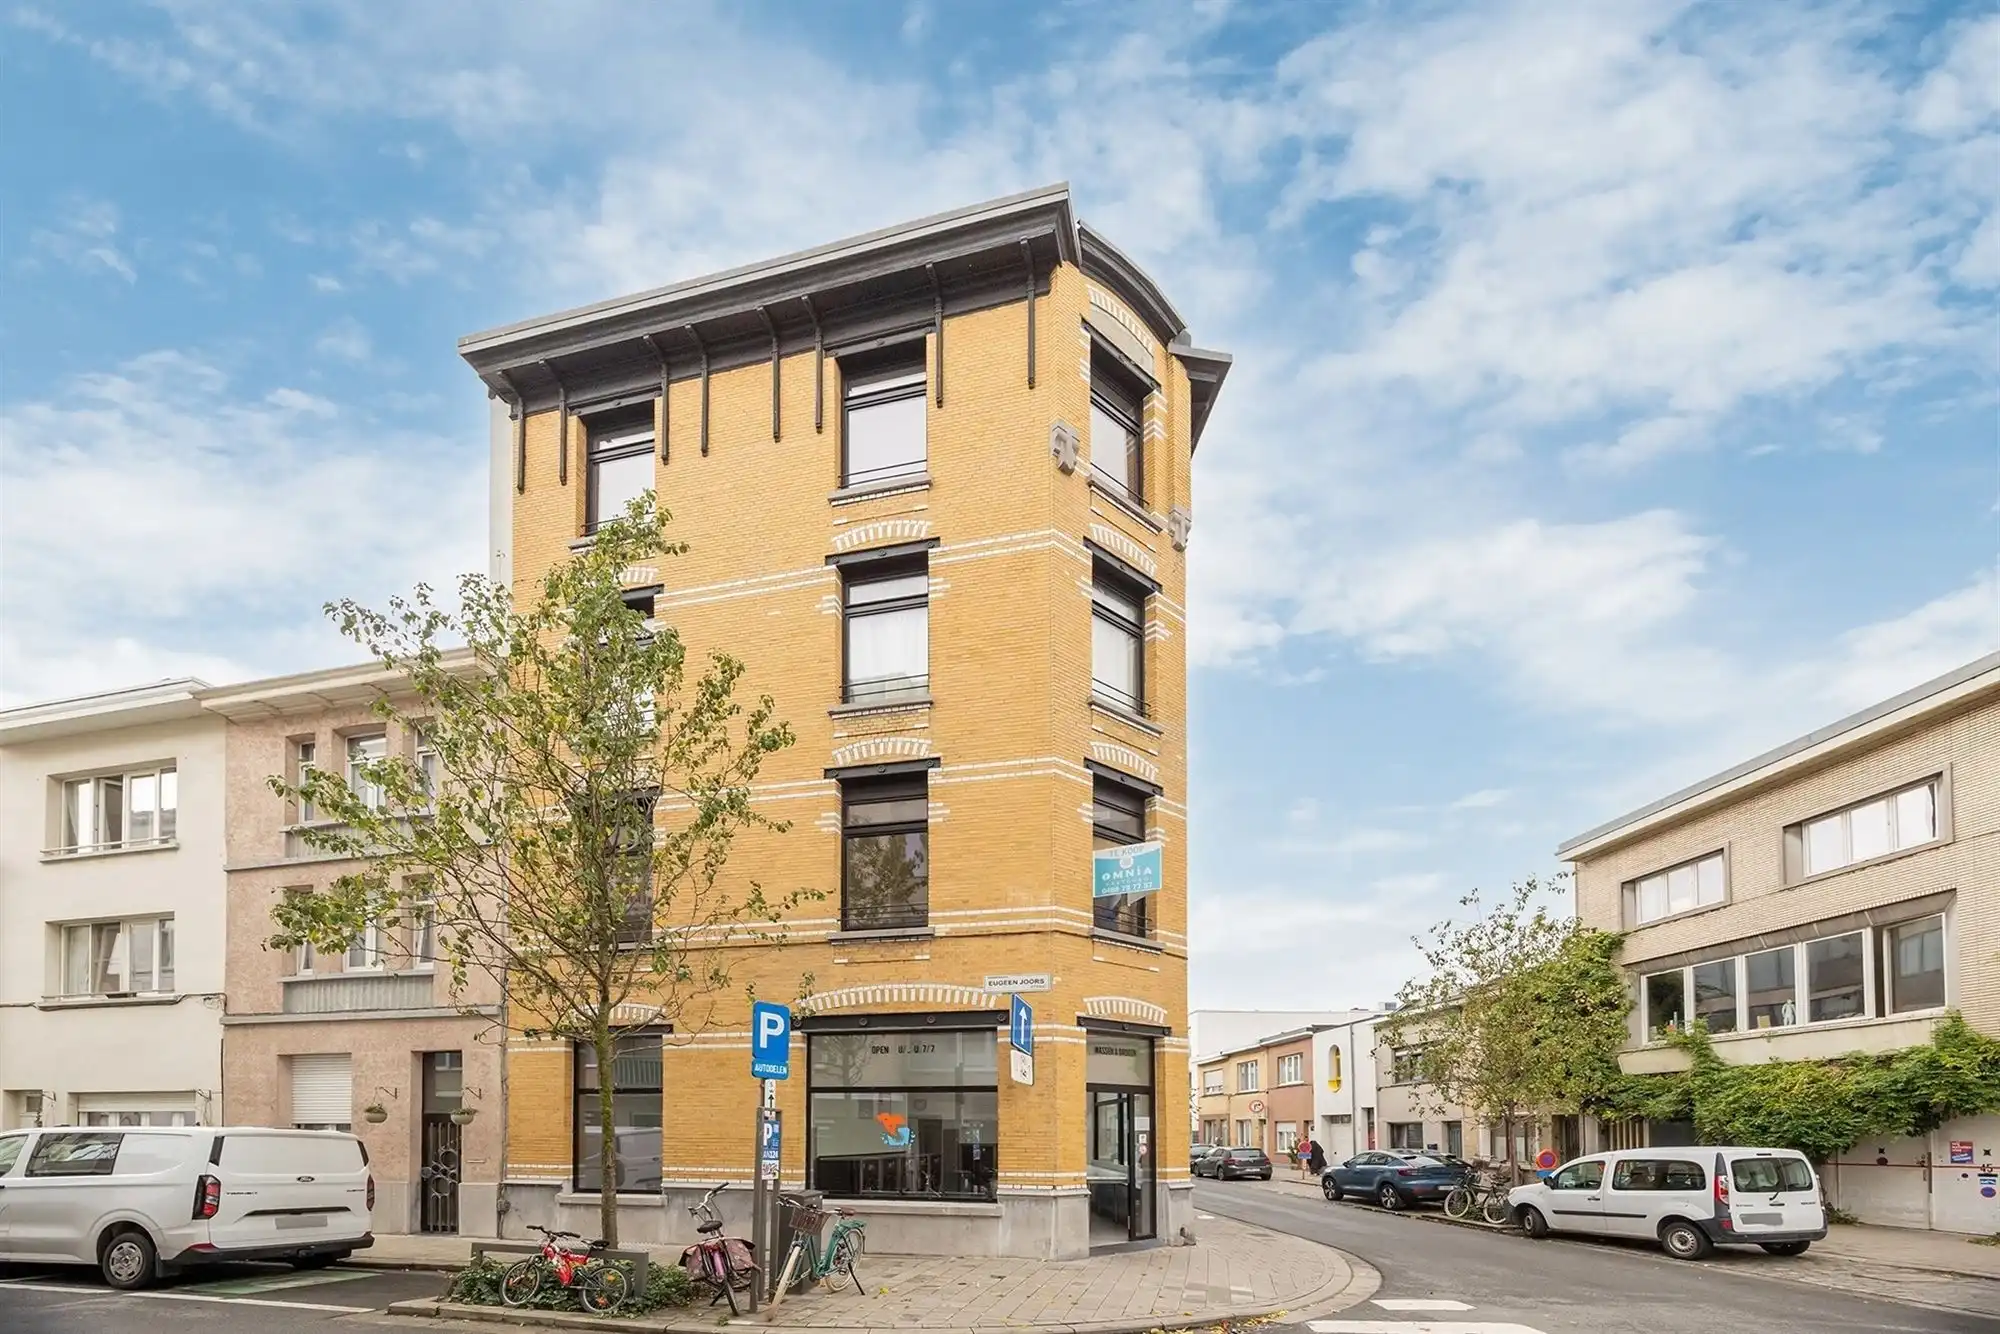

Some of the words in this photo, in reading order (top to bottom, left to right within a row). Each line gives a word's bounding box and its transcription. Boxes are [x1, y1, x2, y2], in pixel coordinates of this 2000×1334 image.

[1102, 866, 1152, 881] OMNIA
[988, 979, 1018, 987] EUGEEN
[1019, 977, 1046, 986] JOORS
[759, 1012, 785, 1049] P
[871, 1045, 890, 1055] OPEN
[754, 1063, 788, 1075] AUTODELEN
[763, 1123, 772, 1146] P
[1980, 1163, 1994, 1173] 45
